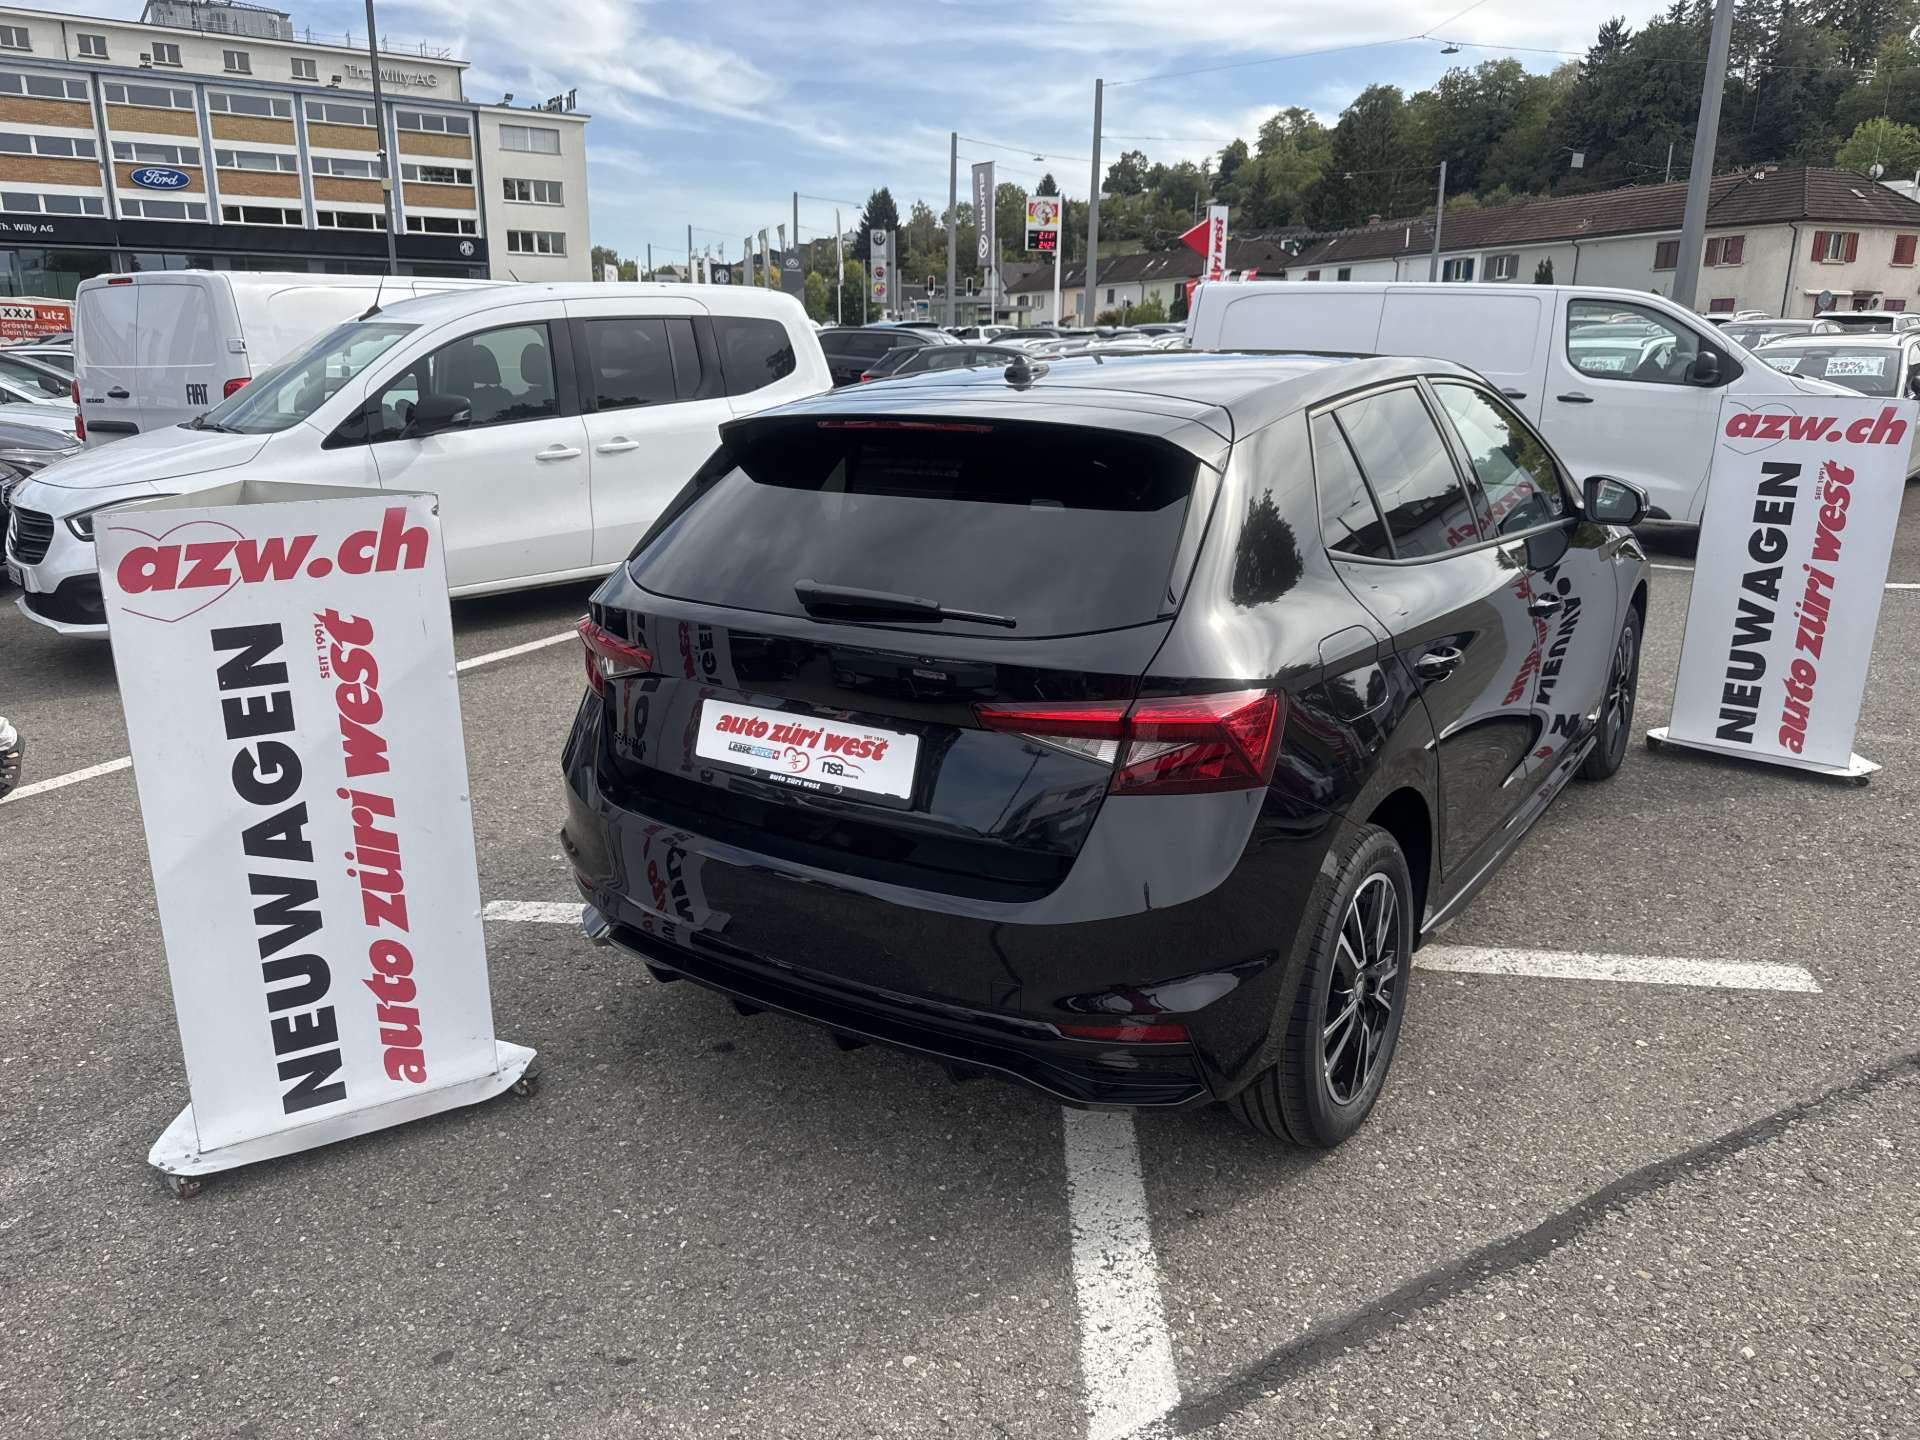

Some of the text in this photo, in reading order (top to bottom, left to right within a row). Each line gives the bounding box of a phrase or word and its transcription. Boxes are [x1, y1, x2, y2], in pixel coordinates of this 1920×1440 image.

[415, 72, 438, 87] AG
[13, 223, 37, 234] Willy
[40, 224, 54, 233] AG
[185, 383, 209, 405] FIAT
[1725, 407, 1908, 445] azw.ch
[1814, 485, 1823, 500] SEIT
[116, 507, 430, 594] azw.ch
[1715, 461, 1802, 744] NEUWAGEN
[1778, 459, 1855, 754] auto züri west
[314, 621, 331, 680] SEIT 1991
[715, 714, 889, 761] auto züri west
[769, 773, 821, 790] auto züri west
[821, 761, 844, 777] nsa
[313, 608, 428, 1085] auto züri west
[210, 622, 347, 1115] NEUWAGEN
